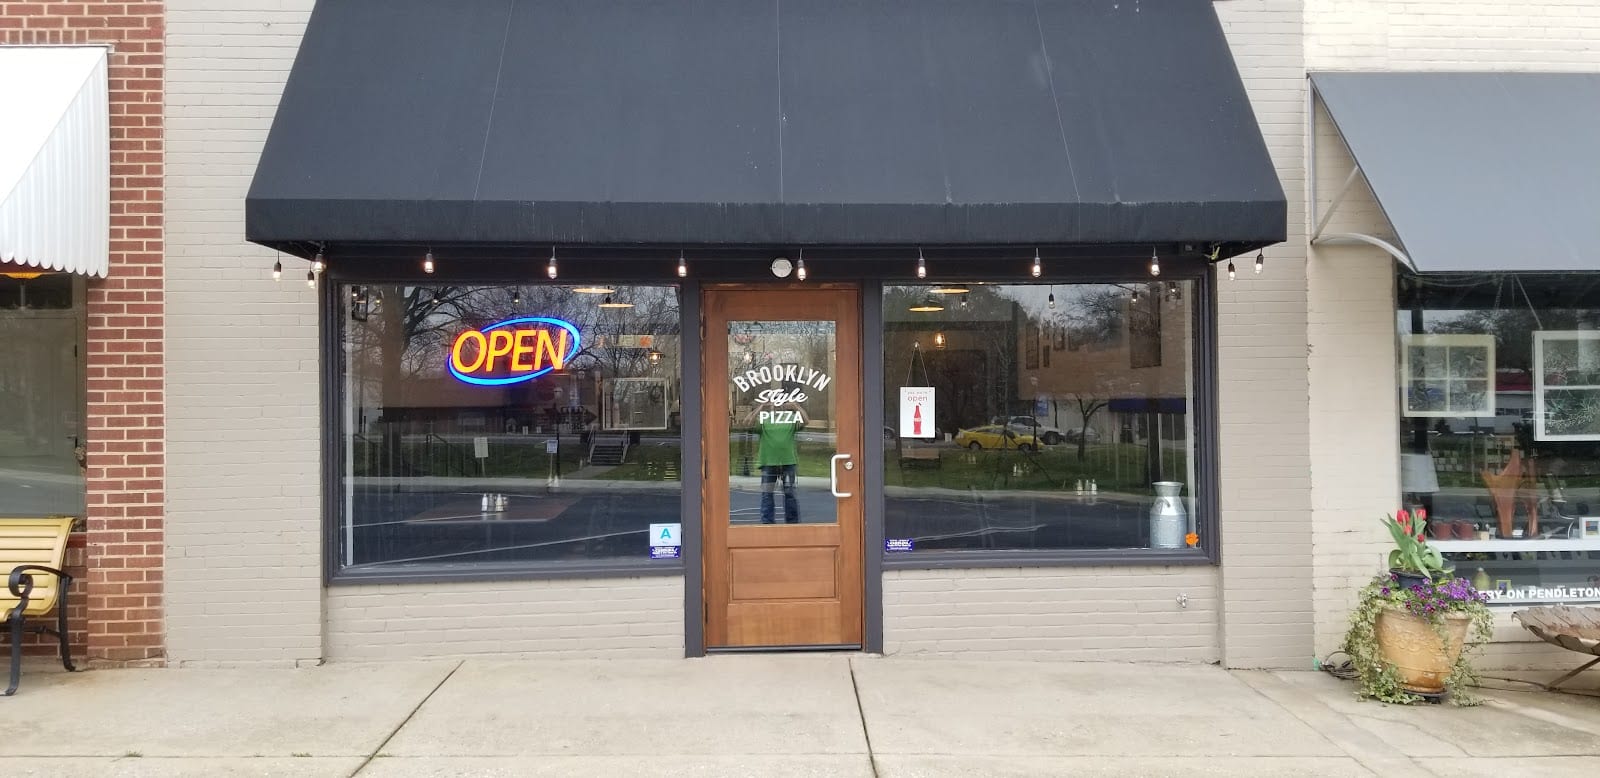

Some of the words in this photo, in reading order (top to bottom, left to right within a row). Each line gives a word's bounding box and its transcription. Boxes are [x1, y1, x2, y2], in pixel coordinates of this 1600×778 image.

[451, 329, 568, 373] OPEN
[733, 364, 832, 393] BROOKLYN
[754, 387, 809, 407] Style
[759, 410, 804, 424] PIZZA
[660, 527, 672, 539] A
[1506, 588, 1526, 599] ON
[1528, 588, 1600, 598] PENDLETON
